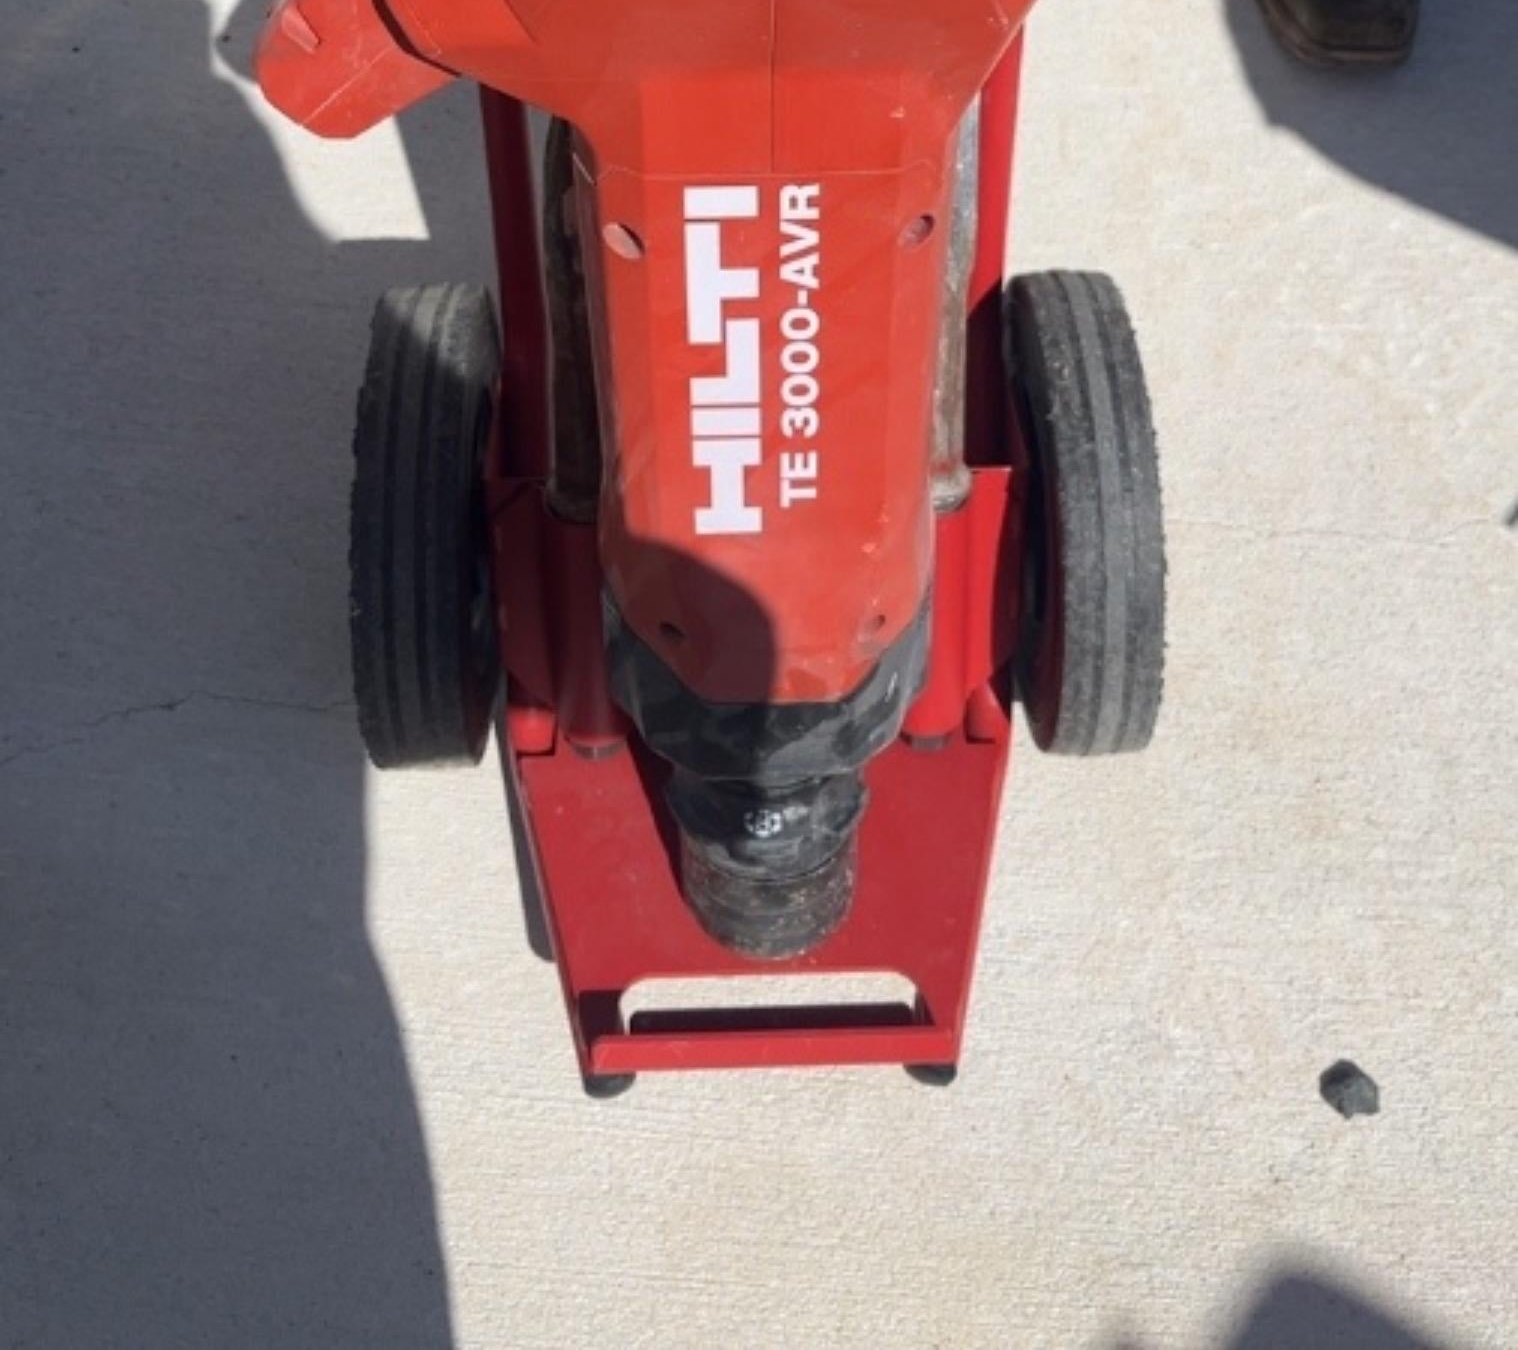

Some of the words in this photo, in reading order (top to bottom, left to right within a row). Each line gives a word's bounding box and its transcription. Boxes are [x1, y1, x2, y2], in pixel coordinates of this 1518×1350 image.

[683, 185, 763, 535] HILTI
[779, 183, 821, 438] 3000-AVR
[779, 450, 818, 508] TE
